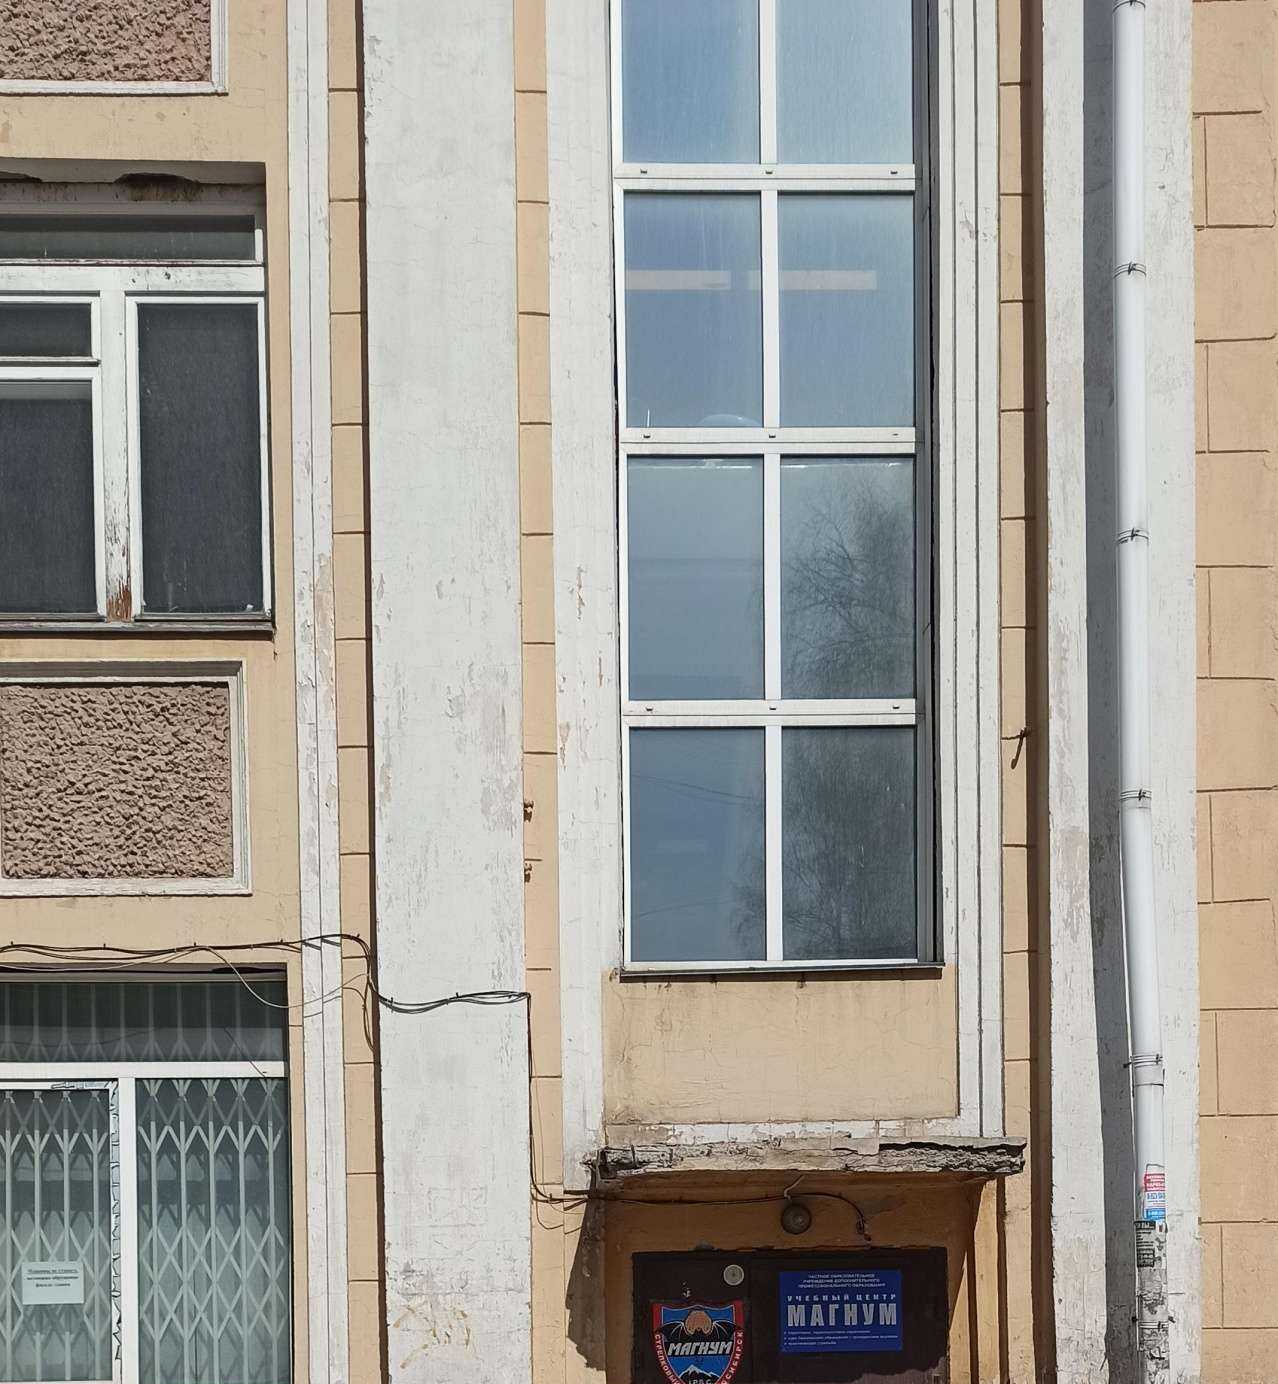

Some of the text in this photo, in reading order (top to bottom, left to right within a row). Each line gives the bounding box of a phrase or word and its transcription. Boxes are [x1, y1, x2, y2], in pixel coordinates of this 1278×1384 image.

[787, 1293, 896, 1302] УЧЕБНЫЙ ЦЕНТР
[787, 1303, 897, 1327] МАГНУМ
[667, 1341, 733, 1356] МАГНУМ
